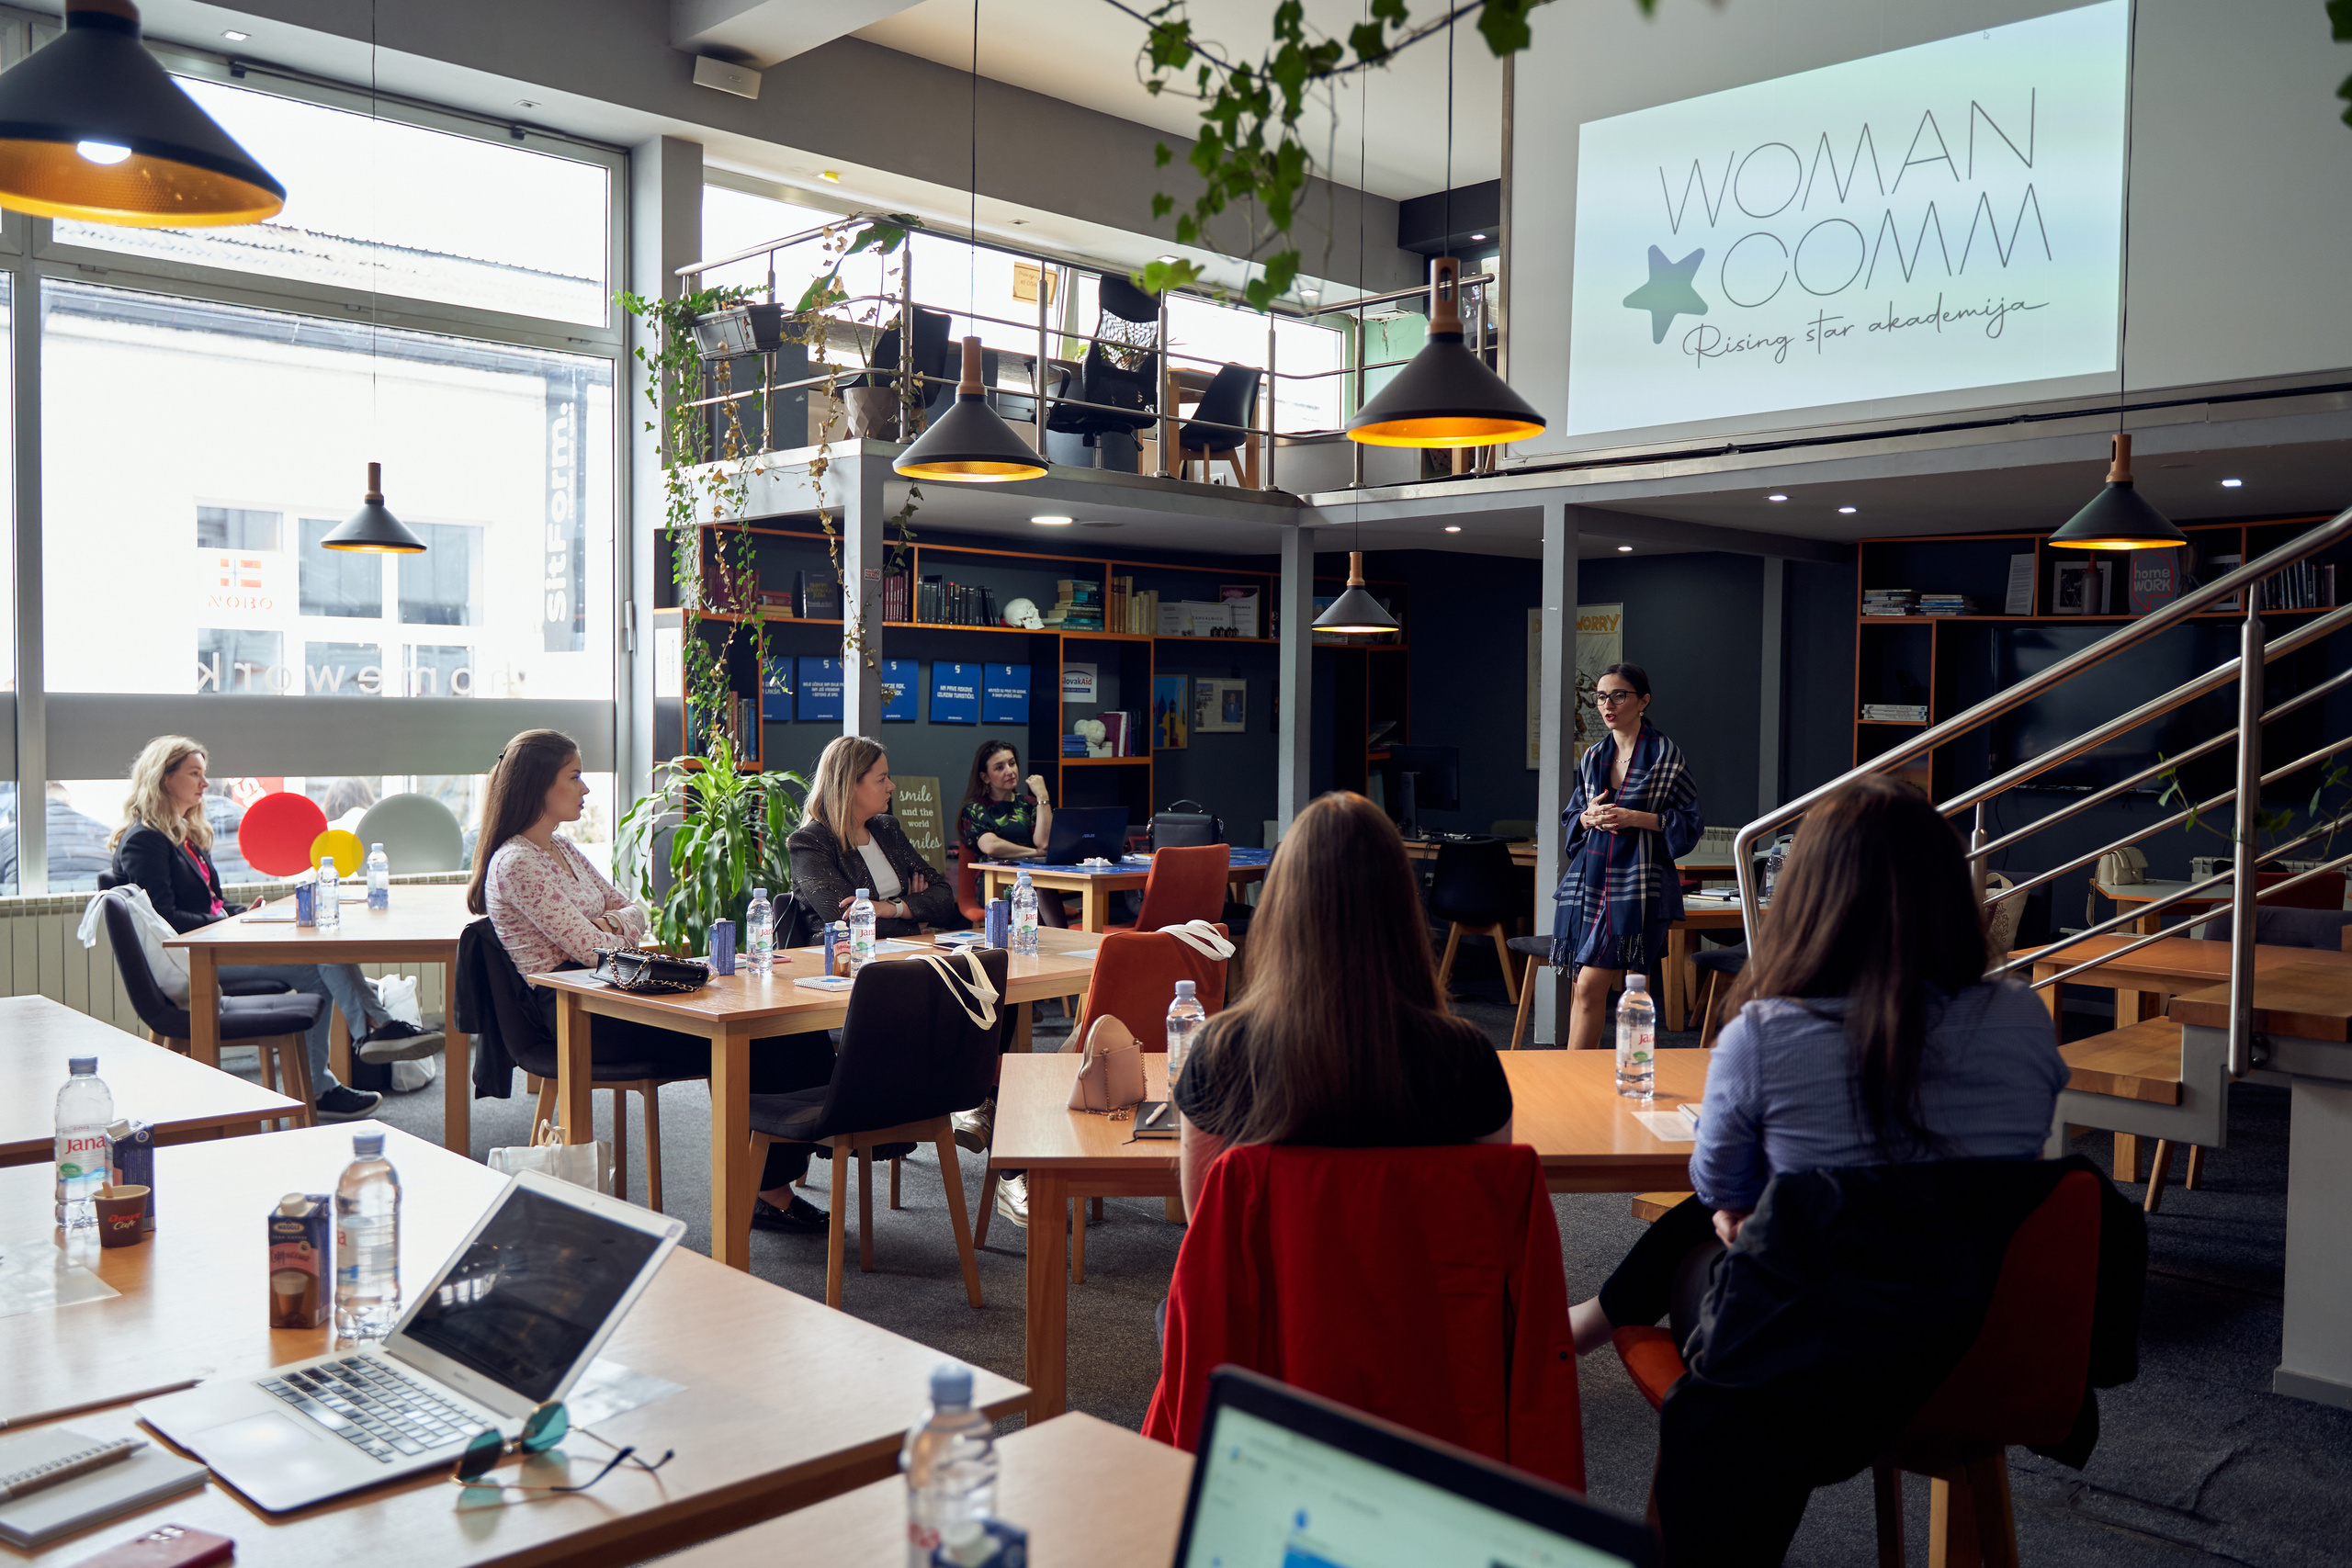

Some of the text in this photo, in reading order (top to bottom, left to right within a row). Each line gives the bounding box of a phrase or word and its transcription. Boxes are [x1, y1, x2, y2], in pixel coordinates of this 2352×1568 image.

[1659, 86, 2036, 235] WOMAN
[1721, 183, 2052, 308] COMM
[1682, 291, 2050, 369] Rising star akademija
[2134, 561, 2170, 579] home
[2134, 579, 2171, 592] WORK
[208, 594, 273, 610] NOBO
[899, 784, 933, 802] smile
[901, 807, 933, 817] and the
[909, 831, 942, 849] miles
[65, 1135, 107, 1155] Jana
